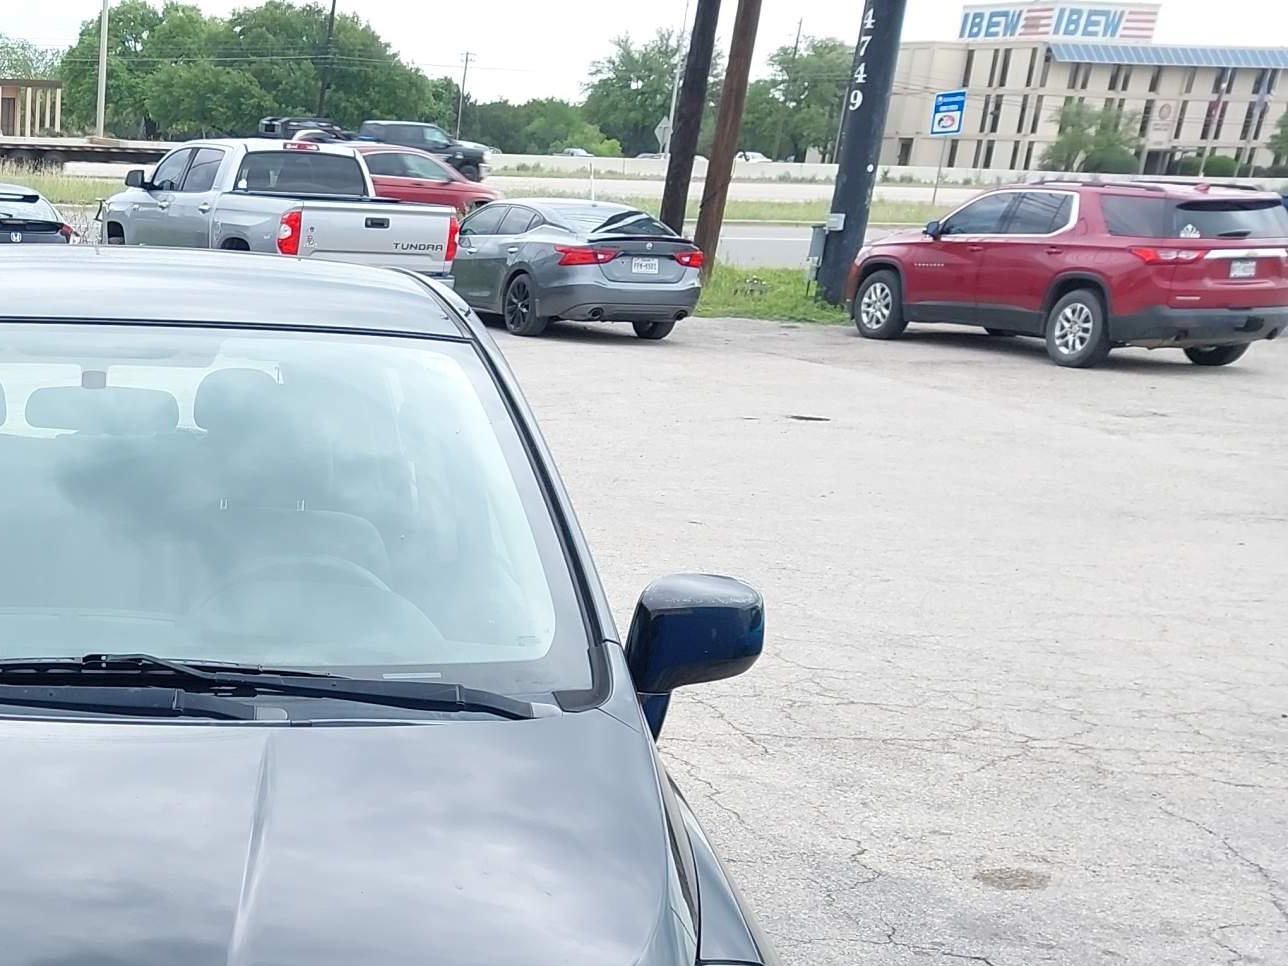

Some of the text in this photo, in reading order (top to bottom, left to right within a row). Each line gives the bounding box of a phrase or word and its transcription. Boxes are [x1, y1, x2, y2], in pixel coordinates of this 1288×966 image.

[959, 7, 1125, 39] IBEW IBEW
[393, 242, 444, 252] TUNDRA
